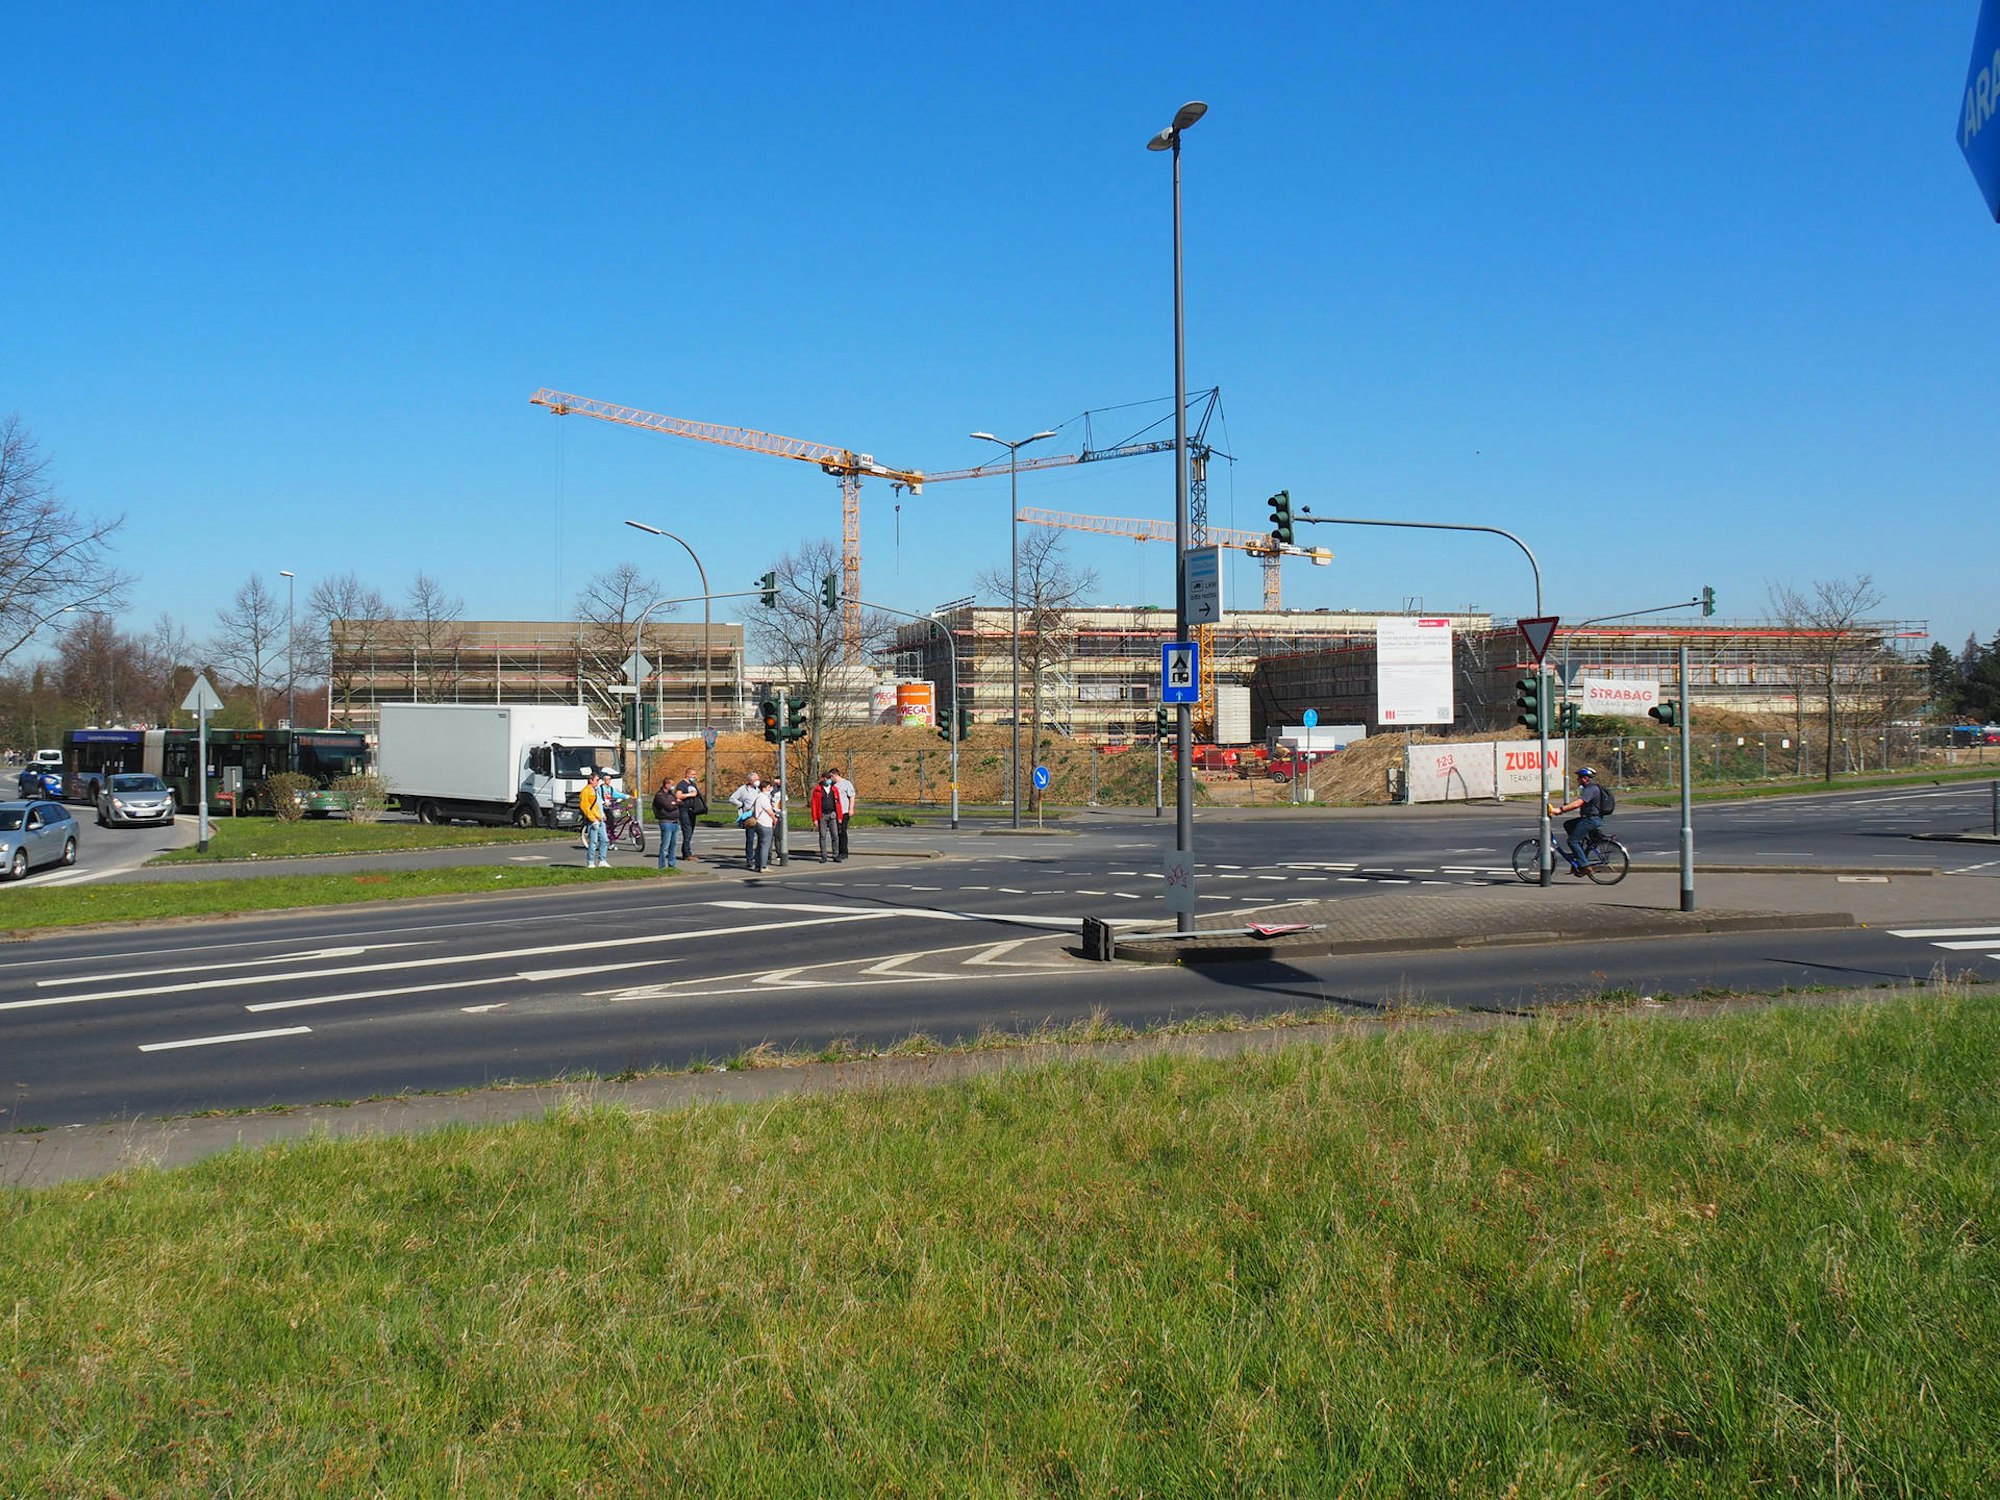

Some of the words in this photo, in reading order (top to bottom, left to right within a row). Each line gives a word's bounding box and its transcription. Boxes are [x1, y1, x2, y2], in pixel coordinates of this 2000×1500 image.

[1590, 688, 1653, 701] STRABAG
[900, 705, 927, 714] MEGA
[1505, 750, 1558, 771] ZÜBLN
